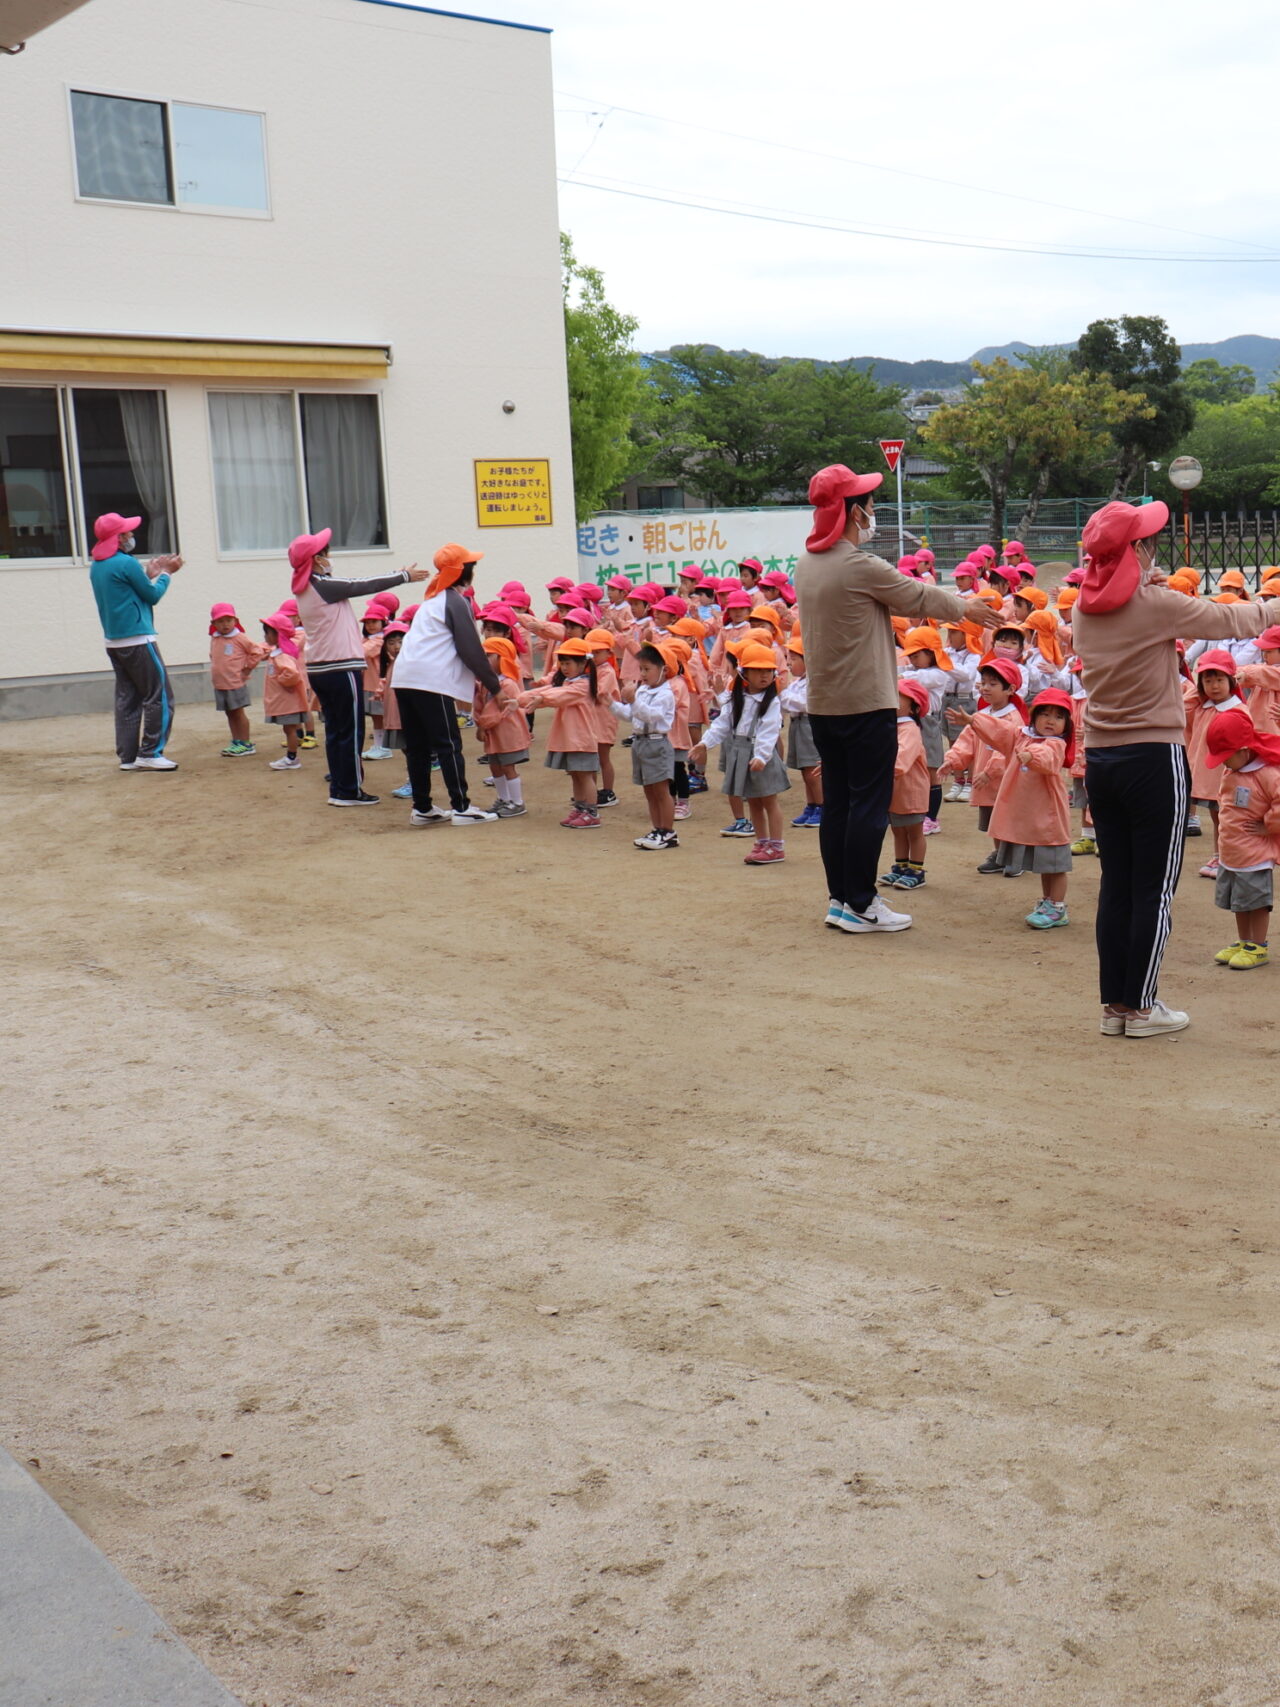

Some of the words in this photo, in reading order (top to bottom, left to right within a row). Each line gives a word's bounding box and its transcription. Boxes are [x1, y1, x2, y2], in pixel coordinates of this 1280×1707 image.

[490, 467, 534, 475] お子様たちが
[481, 479, 545, 487] 大好きなお庭です。
[480, 491, 547, 500] 送迎時はゆっくりと
[486, 503, 543, 512] 運転しましょう。
